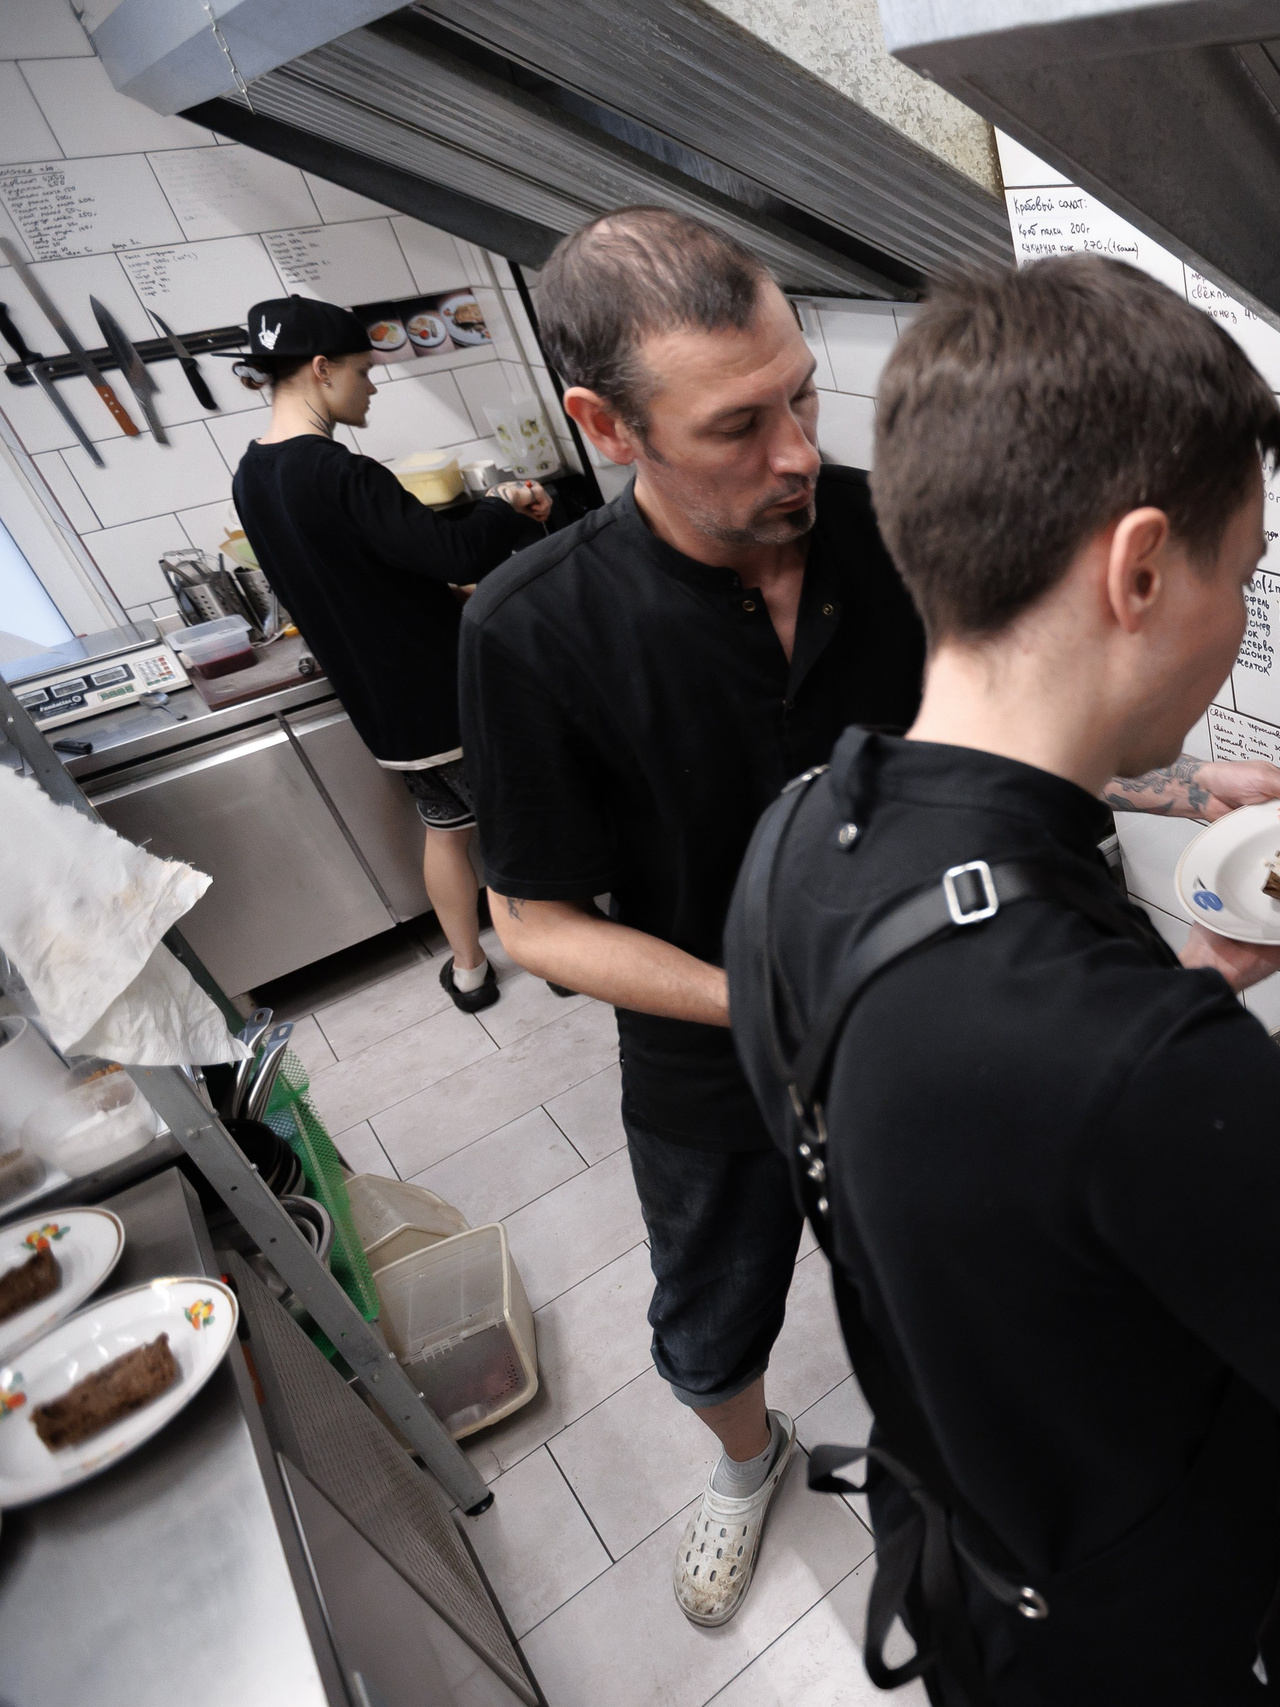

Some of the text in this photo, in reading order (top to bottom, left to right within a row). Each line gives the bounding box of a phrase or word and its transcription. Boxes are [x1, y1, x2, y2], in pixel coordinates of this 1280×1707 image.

[1013, 196, 1087, 215] Крабовый салат:
[1018, 223, 1038, 238] Краб
[1070, 222, 1090, 234] 200г
[1208, 306, 1237, 324] йонез
[1244, 594, 1270, 610] офель
[1240, 647, 1272, 668] айонез
